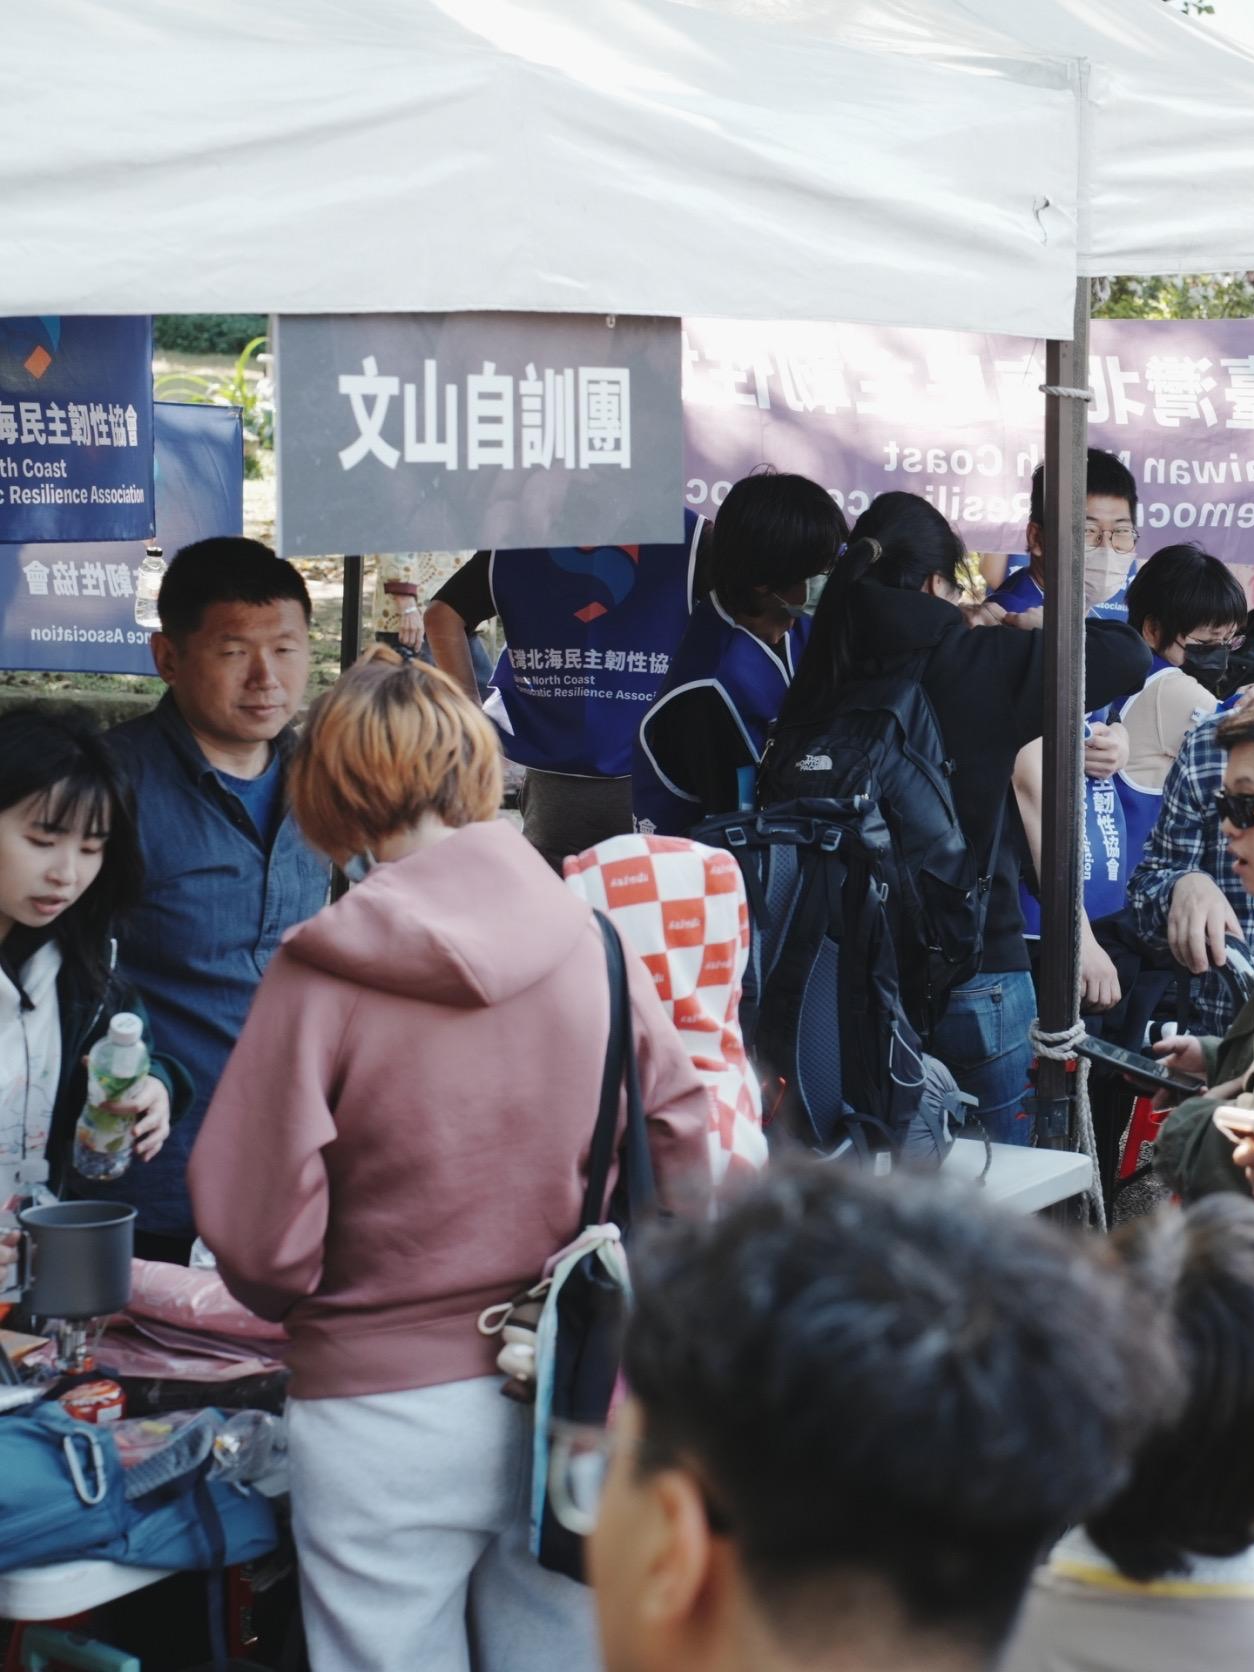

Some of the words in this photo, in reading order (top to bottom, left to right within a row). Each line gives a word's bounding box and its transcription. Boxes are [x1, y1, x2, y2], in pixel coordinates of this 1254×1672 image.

[338, 355, 631, 470] 文山自訓團
[22, 458, 67, 478] Coast
[10, 484, 88, 504] Resilience
[91, 485, 145, 504] Association
[507, 648, 672, 675] 灣北海民主韌性協
[532, 675, 560, 686] North
[563, 675, 595, 686] Coast
[554, 687, 613, 699] Resilience
